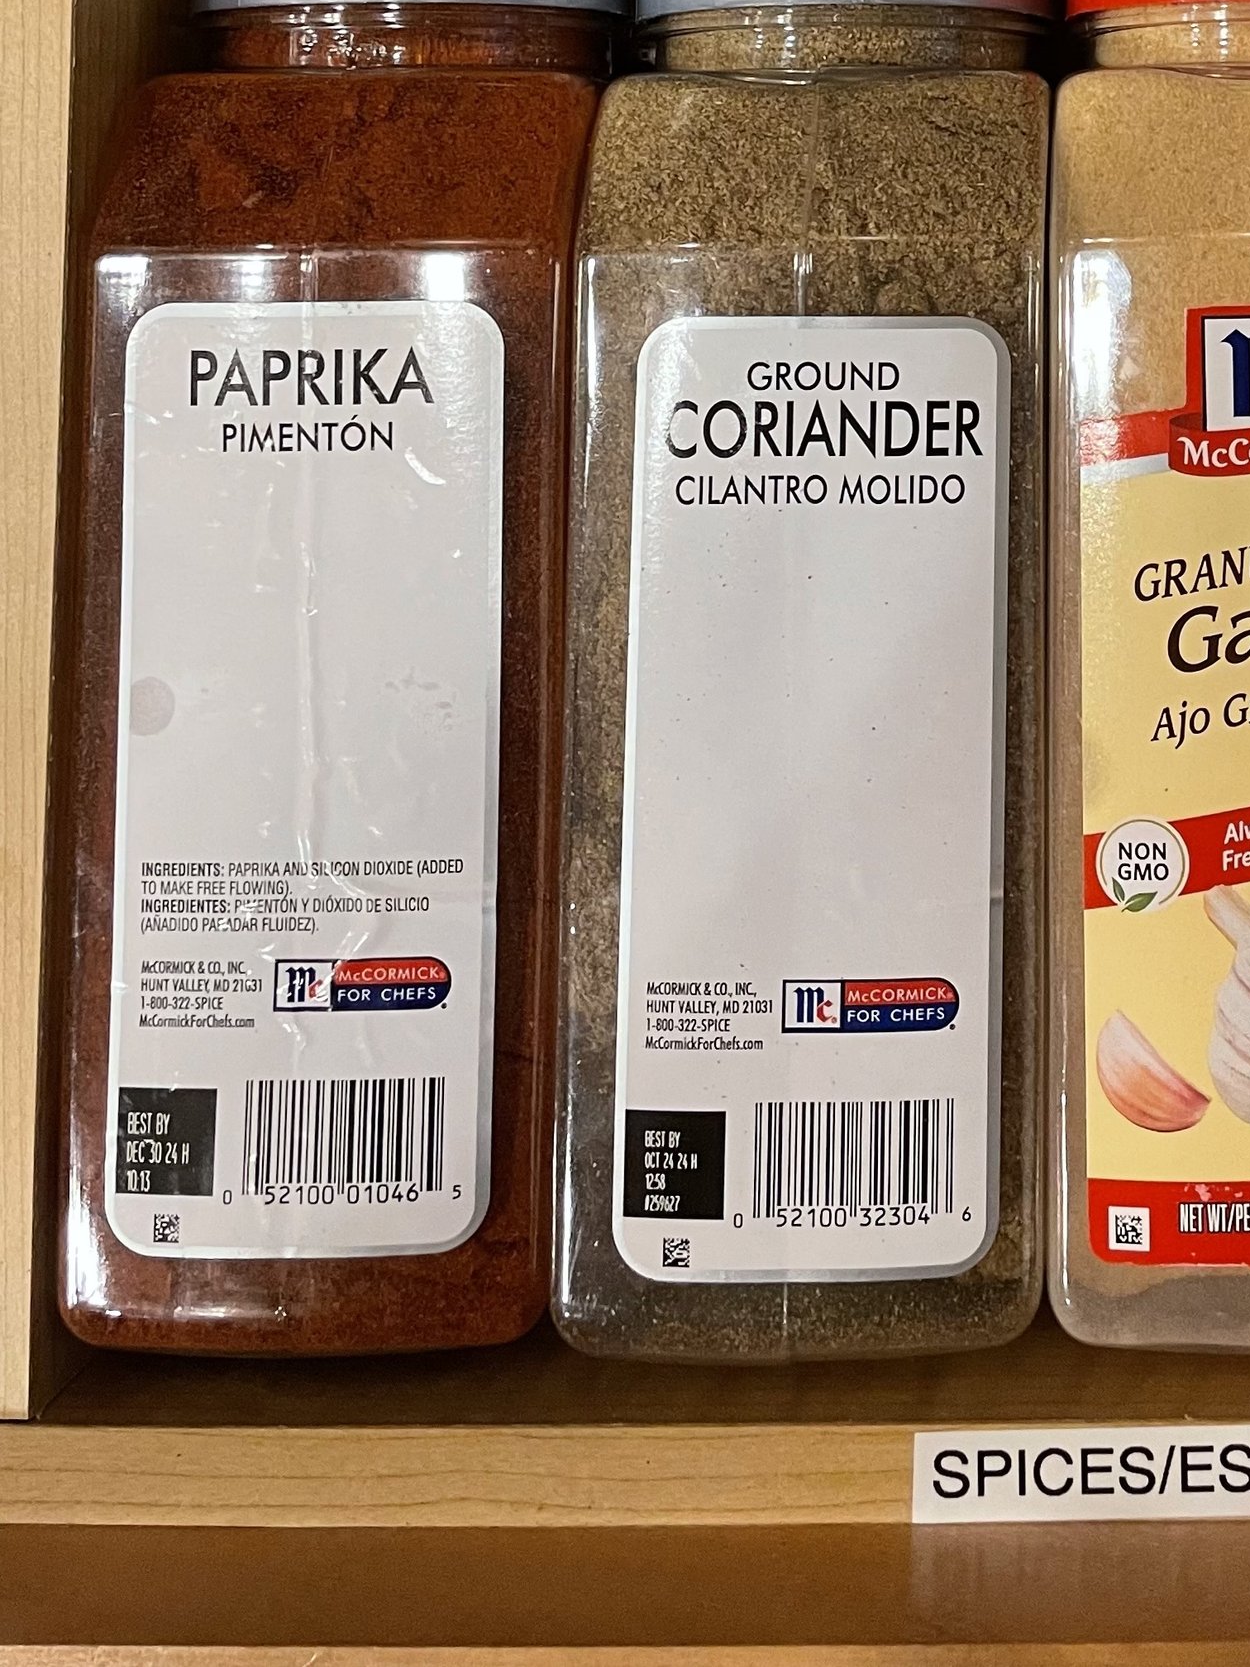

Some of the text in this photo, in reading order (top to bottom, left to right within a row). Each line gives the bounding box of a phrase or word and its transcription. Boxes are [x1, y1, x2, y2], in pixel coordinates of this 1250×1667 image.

[190, 347, 434, 407] PAPRIKA
[747, 361, 900, 391] GROUND
[222, 416, 393, 453] PIMENTÓN
[666, 399, 983, 459] CORIANDER
[676, 474, 965, 505] CILANTRO MOLIDO
[1151, 701, 1210, 749] Ajo
[1118, 842, 1167, 860] NON
[1118, 863, 1169, 880] GMO
[142, 882, 156, 895] TO
[160, 882, 194, 895] MAKE
[197, 881, 226, 895] FREE
[338, 966, 439, 981] McCORMICK
[338, 986, 436, 1002] FOR CHEFS
[646, 1000, 773, 1015] HUNT VALLEY, MD 21031
[646, 1019, 730, 1032] 1-800-322-SPICE
[645, 1037, 763, 1050] McCormickForChefs.com
[645, 1132, 680, 1147] BEST BY
